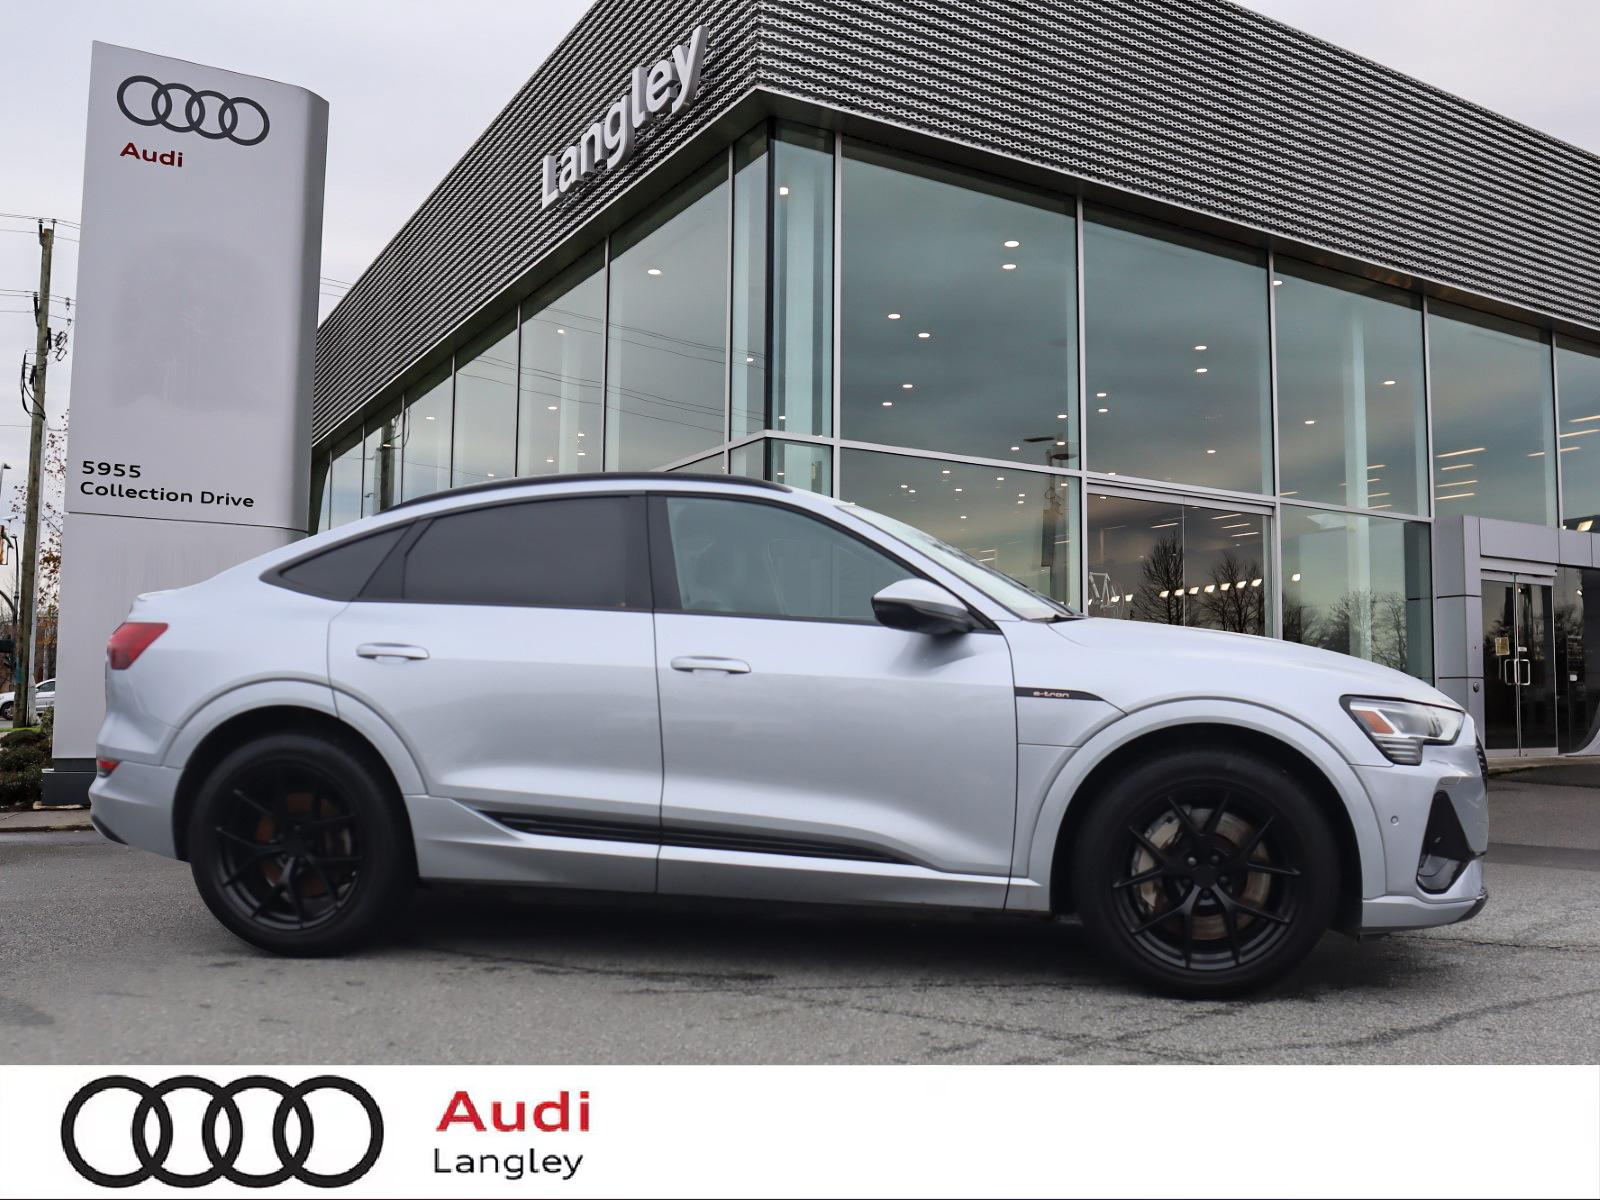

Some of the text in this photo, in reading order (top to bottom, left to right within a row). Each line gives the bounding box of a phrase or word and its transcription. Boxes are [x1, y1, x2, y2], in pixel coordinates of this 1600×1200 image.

[541, 25, 710, 209] Langley
[119, 142, 183, 168] Audi
[82, 460, 142, 479] 5955
[80, 481, 255, 508] Collection Drive
